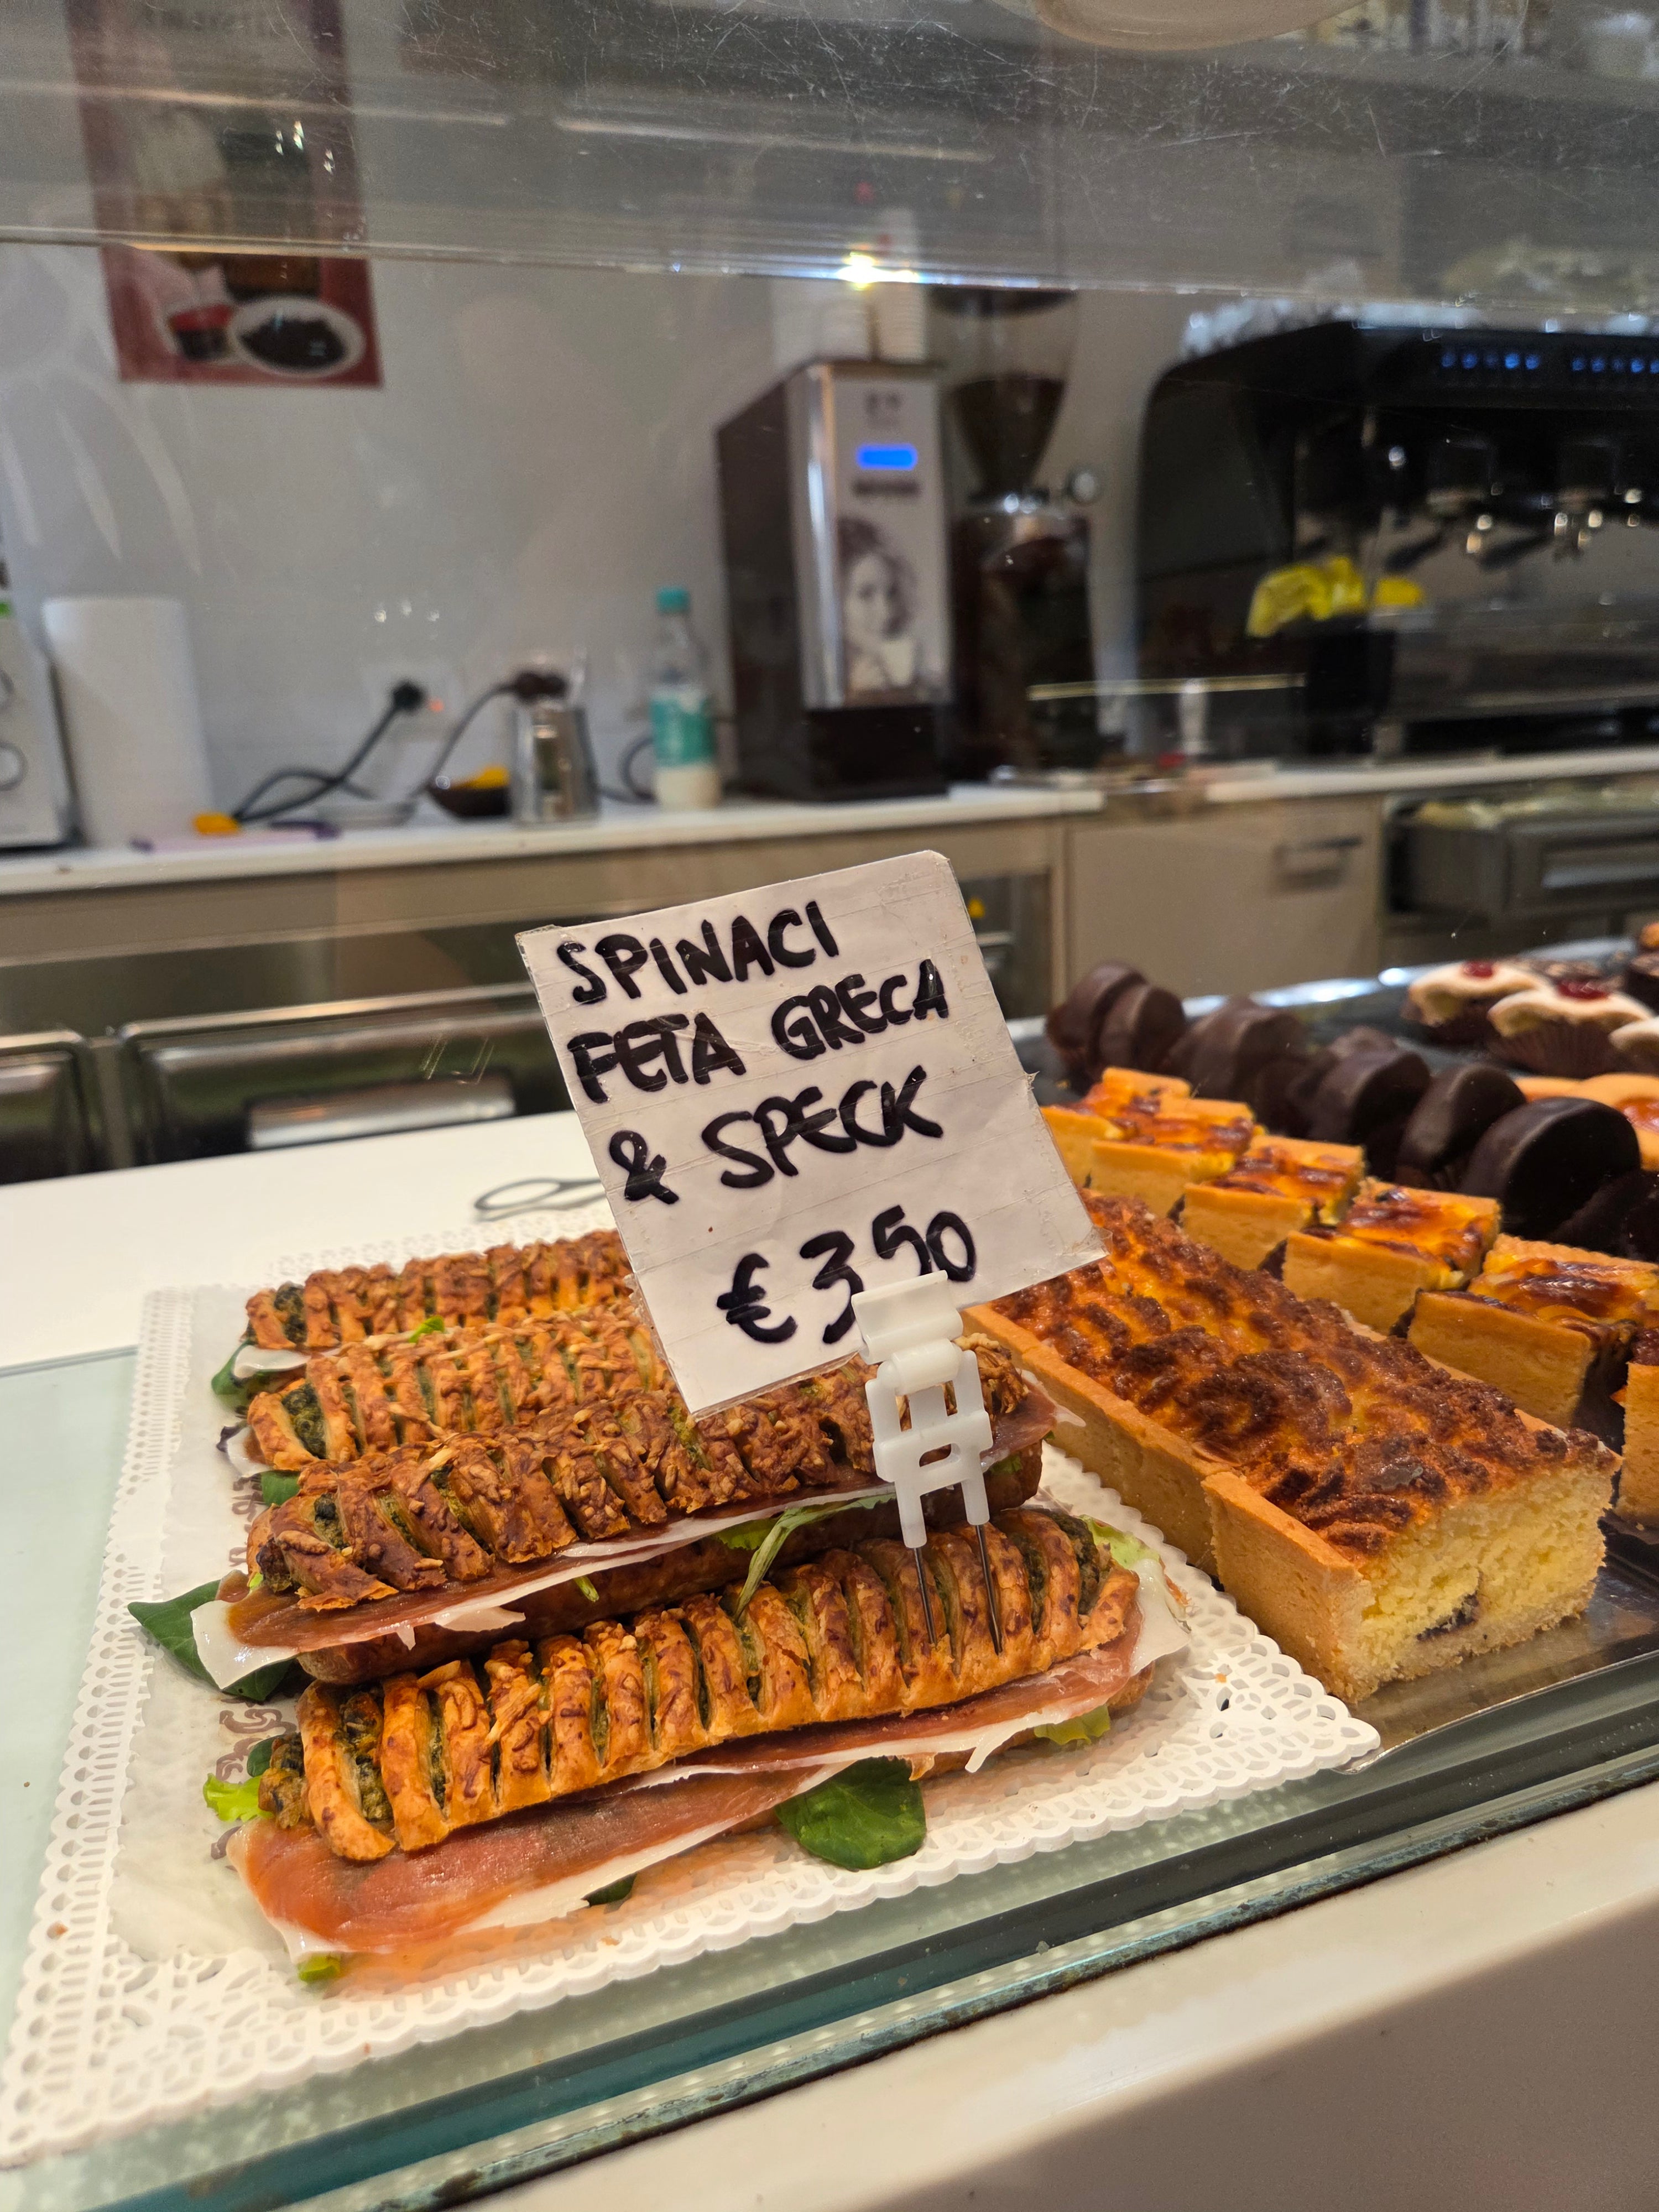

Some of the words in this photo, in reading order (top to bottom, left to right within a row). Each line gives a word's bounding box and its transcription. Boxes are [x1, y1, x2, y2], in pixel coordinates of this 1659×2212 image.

[556, 900, 840, 1005] SPINACI
[566, 1012, 747, 1104] FETA
[770, 959, 949, 1061] GRECA
[608, 1130, 680, 1205] &
[701, 1065, 944, 1189] SPECK
